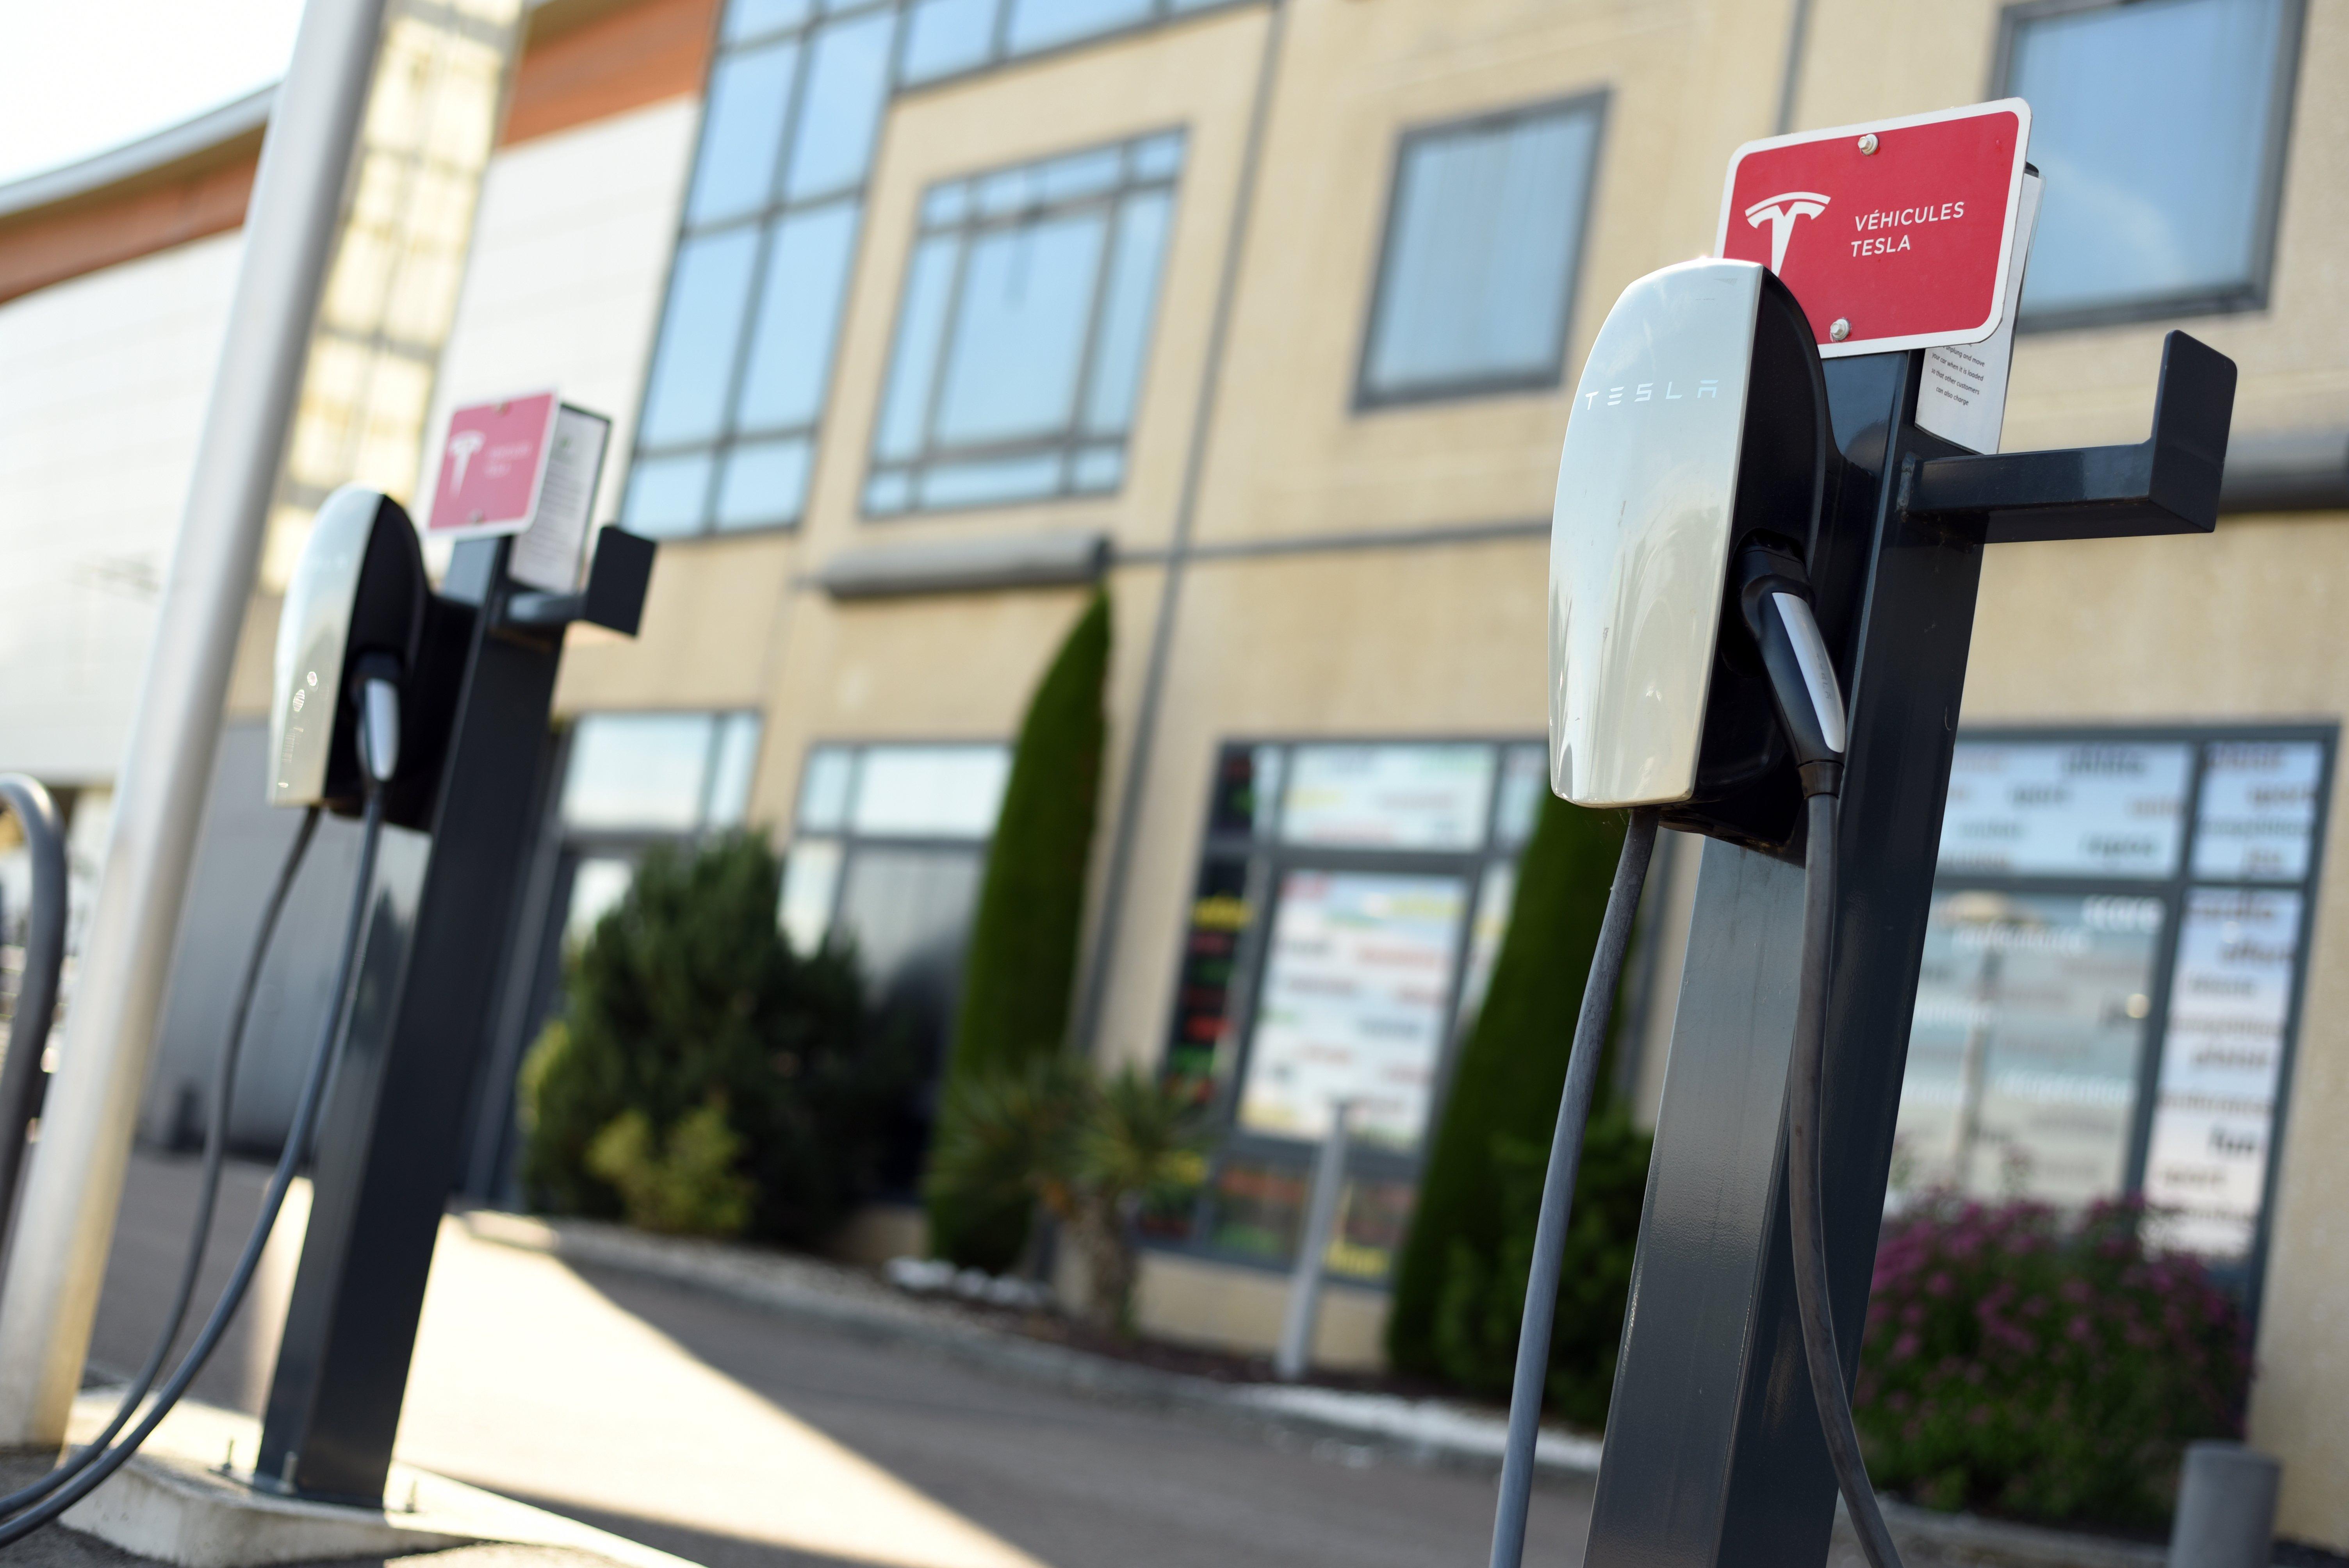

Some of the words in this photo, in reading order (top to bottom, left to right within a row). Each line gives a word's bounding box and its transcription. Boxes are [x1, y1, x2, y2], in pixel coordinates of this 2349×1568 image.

[1855, 201, 1965, 232] VÉHICULES
[1850, 234, 1911, 258] TESLA
[1947, 362, 1959, 371] when
[1968, 369, 1984, 381] loaded
[1972, 358, 1985, 367] move
[1936, 370, 1944, 379] that
[1944, 376, 1956, 385] other
[1956, 381, 1980, 395] customers
[1585, 380, 1718, 410] TESLA
[1953, 394, 1969, 406] charge
